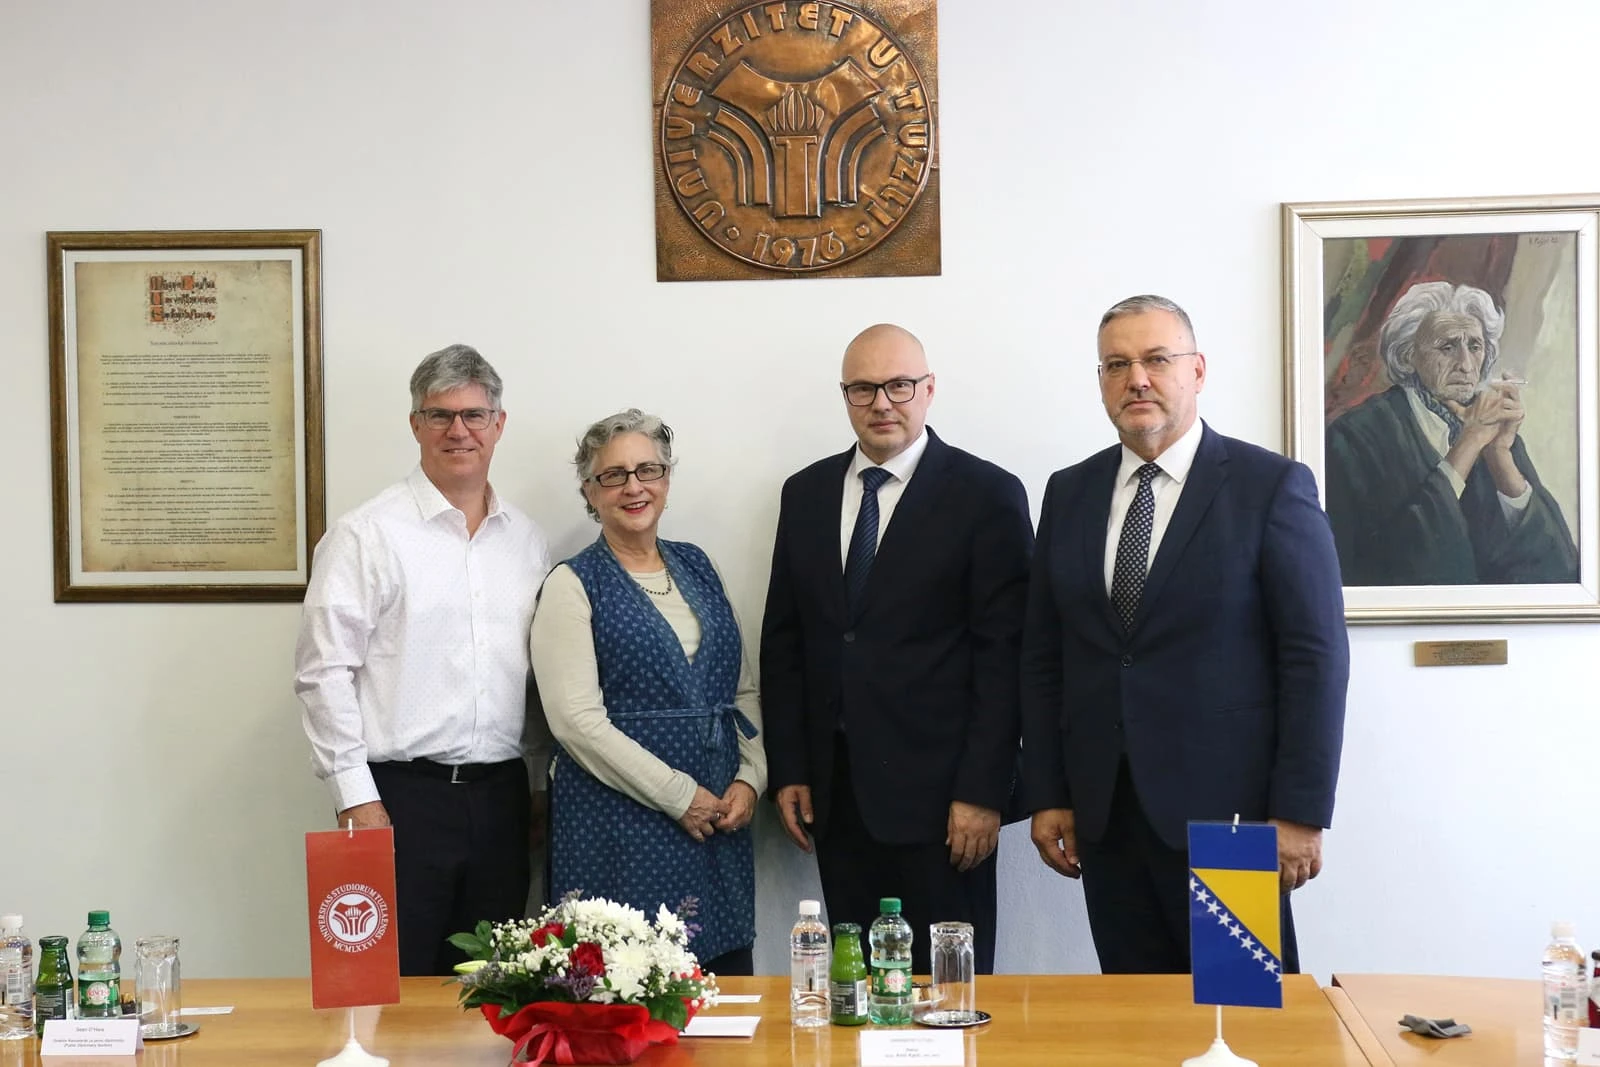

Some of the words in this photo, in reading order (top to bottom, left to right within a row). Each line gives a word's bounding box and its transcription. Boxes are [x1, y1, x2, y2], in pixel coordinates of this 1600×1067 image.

[868, 39, 901, 68] U
[666, 2, 853, 230] UNIVERZITET
[865, 83, 929, 230] TUZLI
[752, 232, 845, 266] 1976
[318, 894, 334, 943] UNIVERSITAS
[331, 883, 377, 897] STUDIORUM
[333, 938, 377, 953] MCMLXXVI
